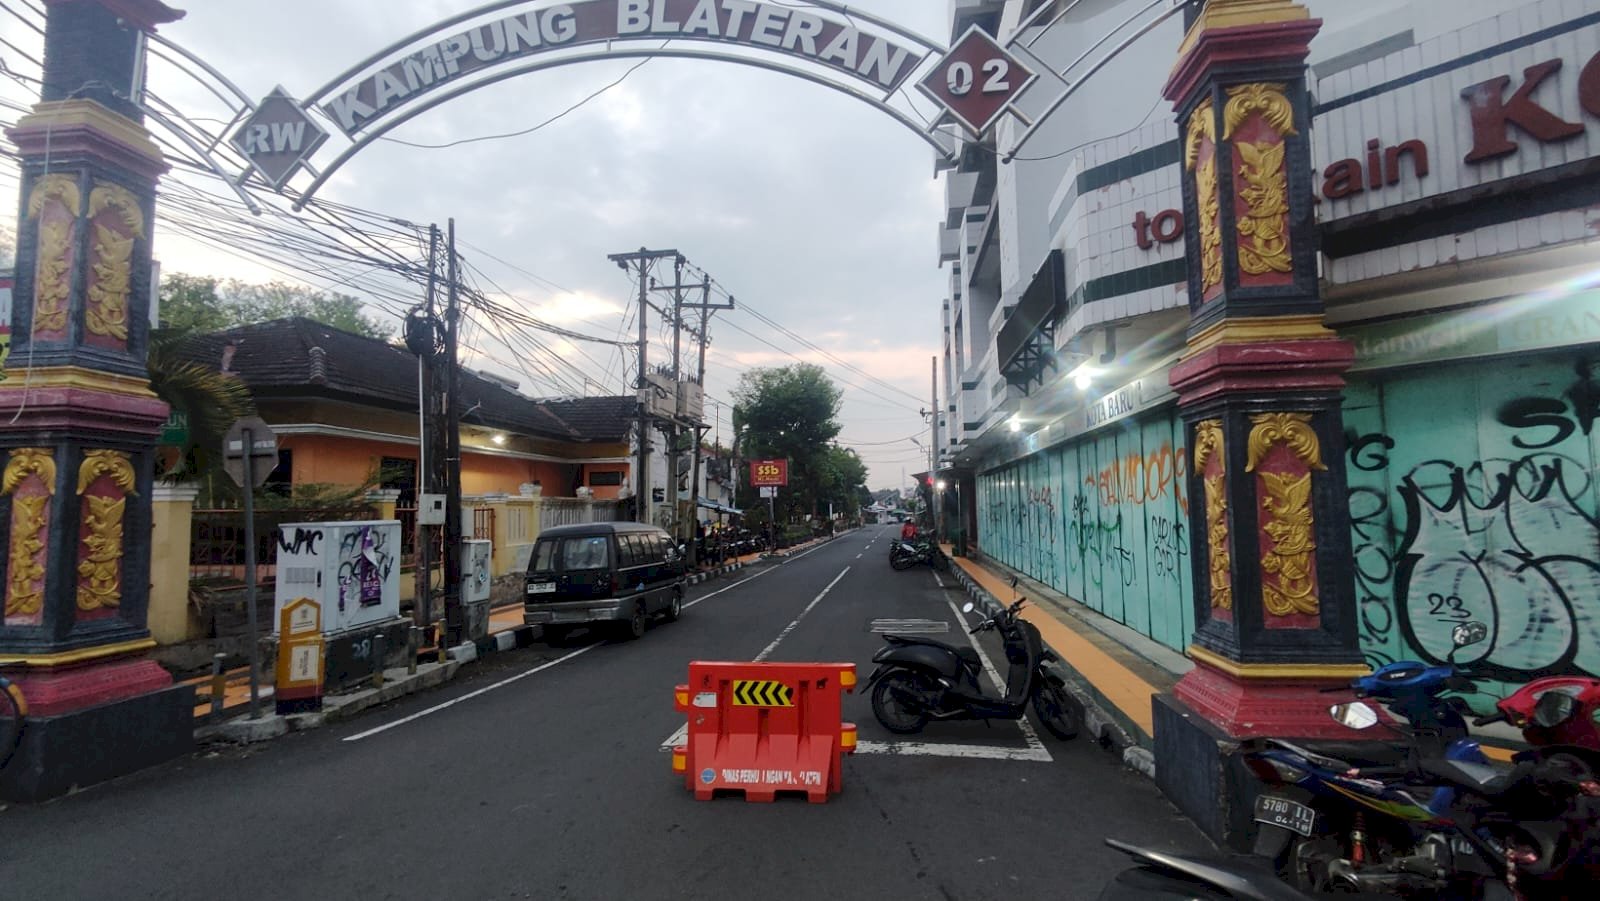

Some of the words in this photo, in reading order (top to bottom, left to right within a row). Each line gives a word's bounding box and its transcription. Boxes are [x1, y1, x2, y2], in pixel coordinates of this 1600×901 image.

[332, 4, 577, 130] KAMPUNG
[616, 0, 908, 86] BLATERAN
[947, 59, 1010, 96] 02
[245, 121, 306, 155] RW
[1312, 138, 1430, 204] ain
[1086, 403, 1106, 428] KOTA
[1108, 388, 1134, 419] BARU
[1427, 593, 1472, 619] 23
[1263, 799, 1289, 813] 5780
